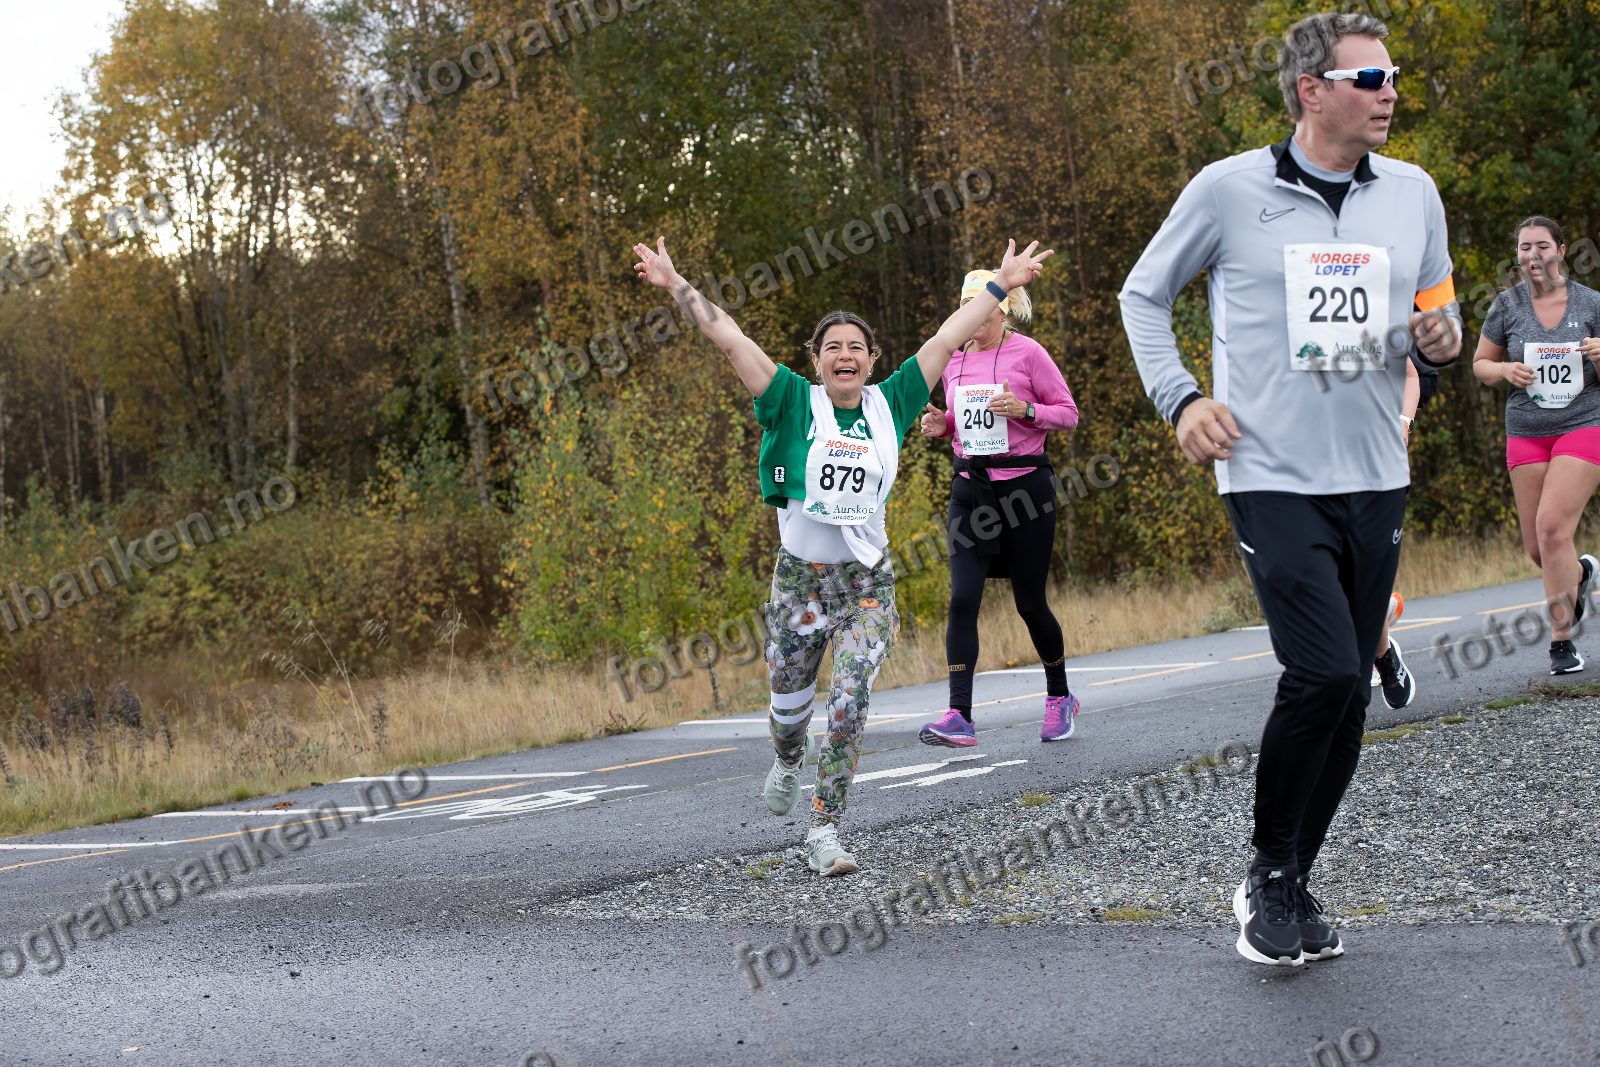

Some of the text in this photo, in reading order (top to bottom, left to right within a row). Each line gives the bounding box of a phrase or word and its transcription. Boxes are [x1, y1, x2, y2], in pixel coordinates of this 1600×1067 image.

[1309, 253, 1371, 264] NORGES
[1315, 265, 1361, 276] LØPET
[1308, 286, 1369, 324] 220
[1536, 364, 1572, 385] 102
[963, 408, 995, 430] 240
[826, 439, 869, 454] NORGES
[828, 449, 863, 460] LØPET
[819, 463, 866, 494] 879
